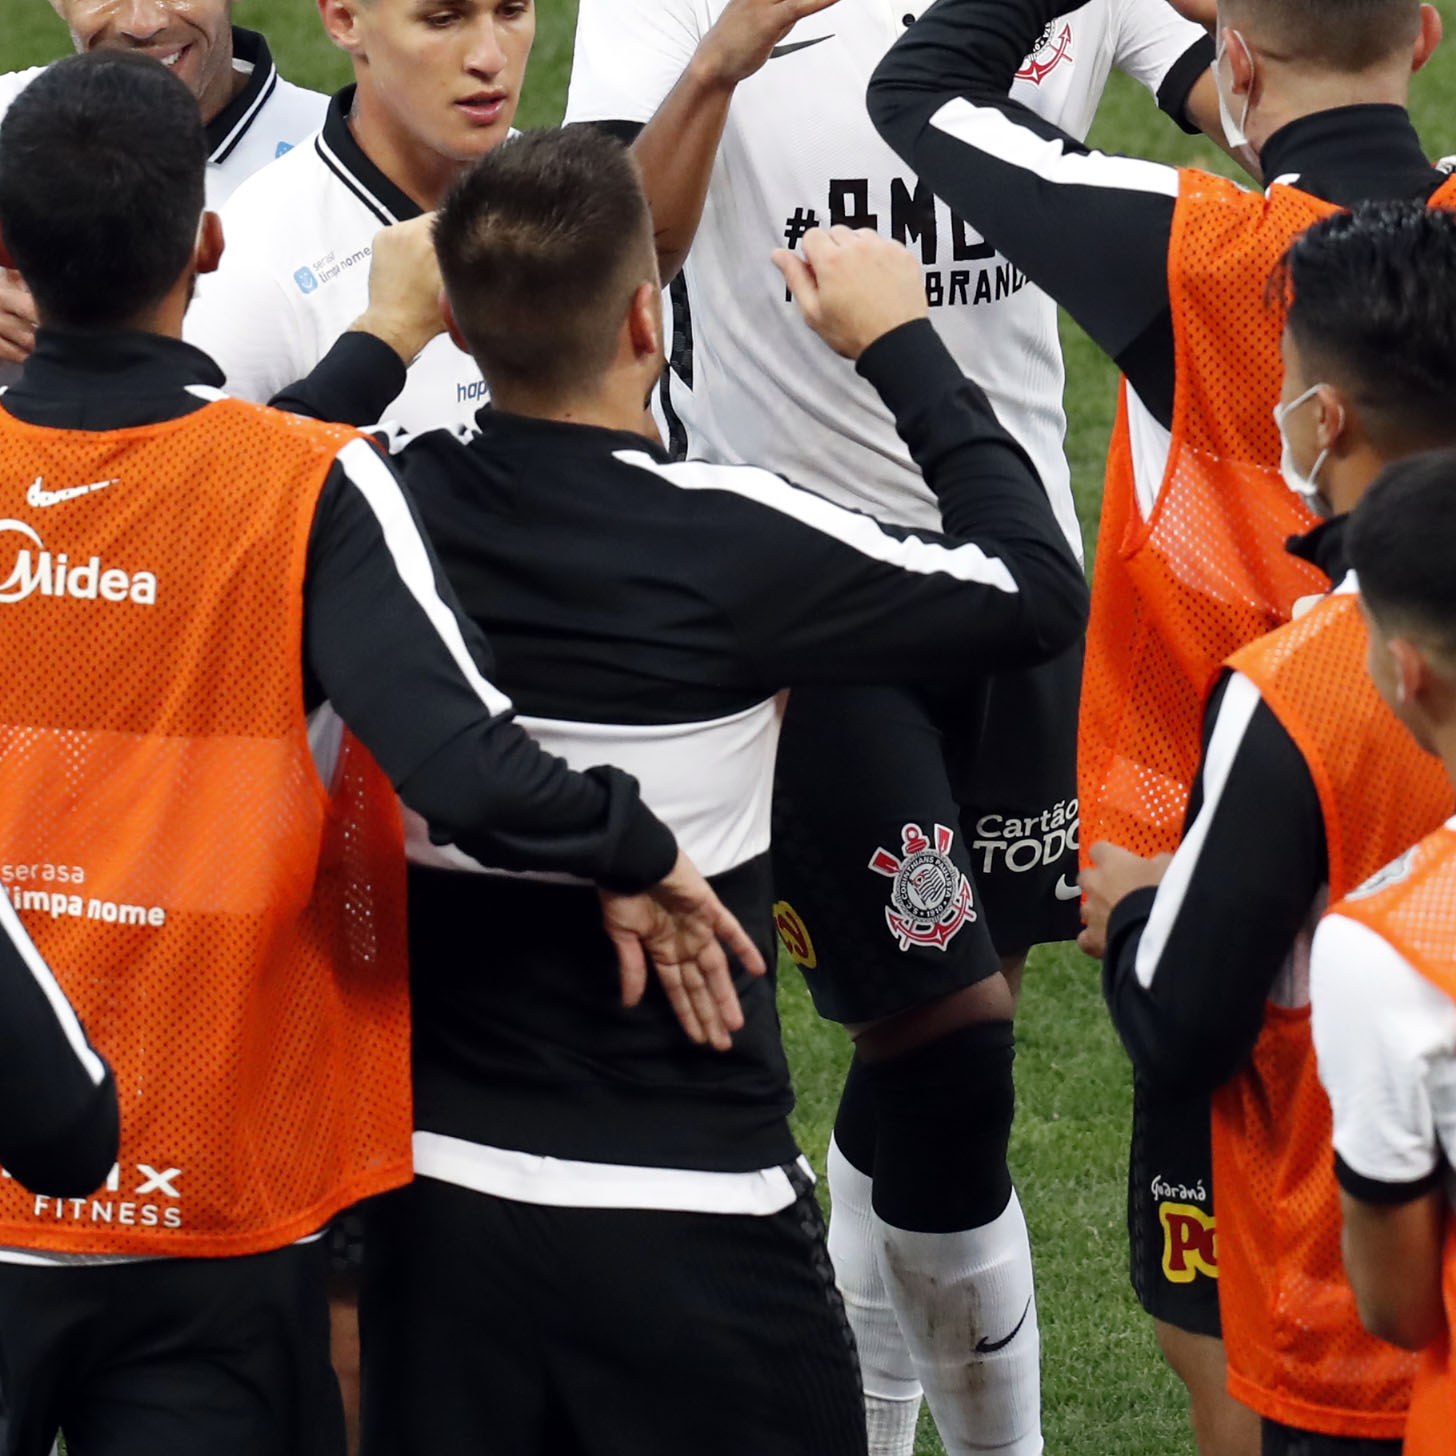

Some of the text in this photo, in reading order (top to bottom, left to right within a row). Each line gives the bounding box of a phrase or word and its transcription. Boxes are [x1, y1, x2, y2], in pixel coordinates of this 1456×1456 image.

[339, 246, 372, 271] nome
[975, 798, 1079, 839] Cartão
[1, 862, 85, 884] serasa
[6, 885, 166, 927] impa nome
[1151, 1174, 1207, 1201] Guaraná
[34, 1194, 183, 1229] FITNESS
